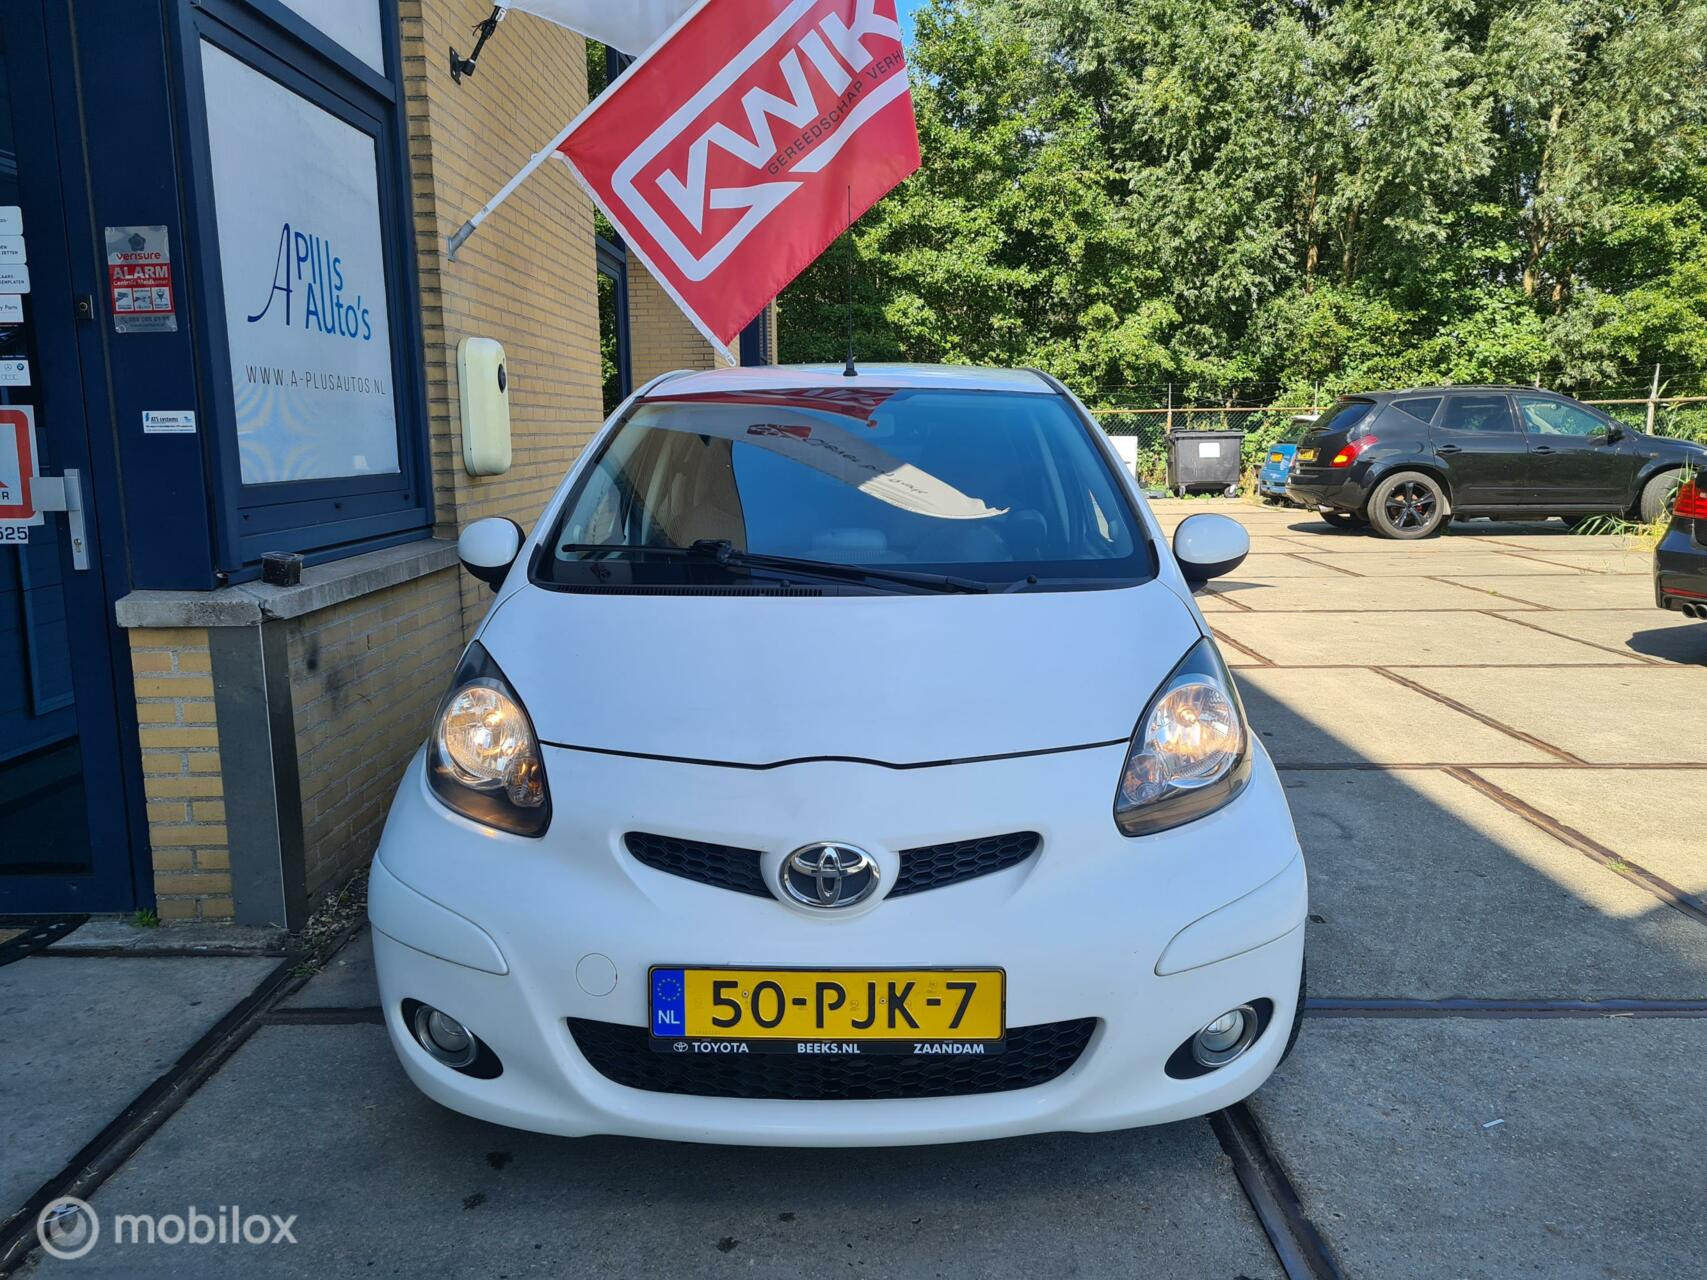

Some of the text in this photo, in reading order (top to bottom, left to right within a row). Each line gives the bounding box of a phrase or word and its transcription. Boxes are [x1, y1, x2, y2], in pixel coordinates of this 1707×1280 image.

[655, 0, 901, 235] KWIK
[767, 48, 905, 176] GEREEDSCHAP VERH
[116, 251, 161, 261] verisure
[113, 266, 168, 279] ALARM
[245, 365, 386, 395] WWW.A-PLUSAUTOS.NL
[712, 980, 977, 1029] 50-PJK-7
[658, 1010, 680, 1024] NL
[692, 1042, 985, 1054] TOYOTA BEEKS.NL ZAANDAM
